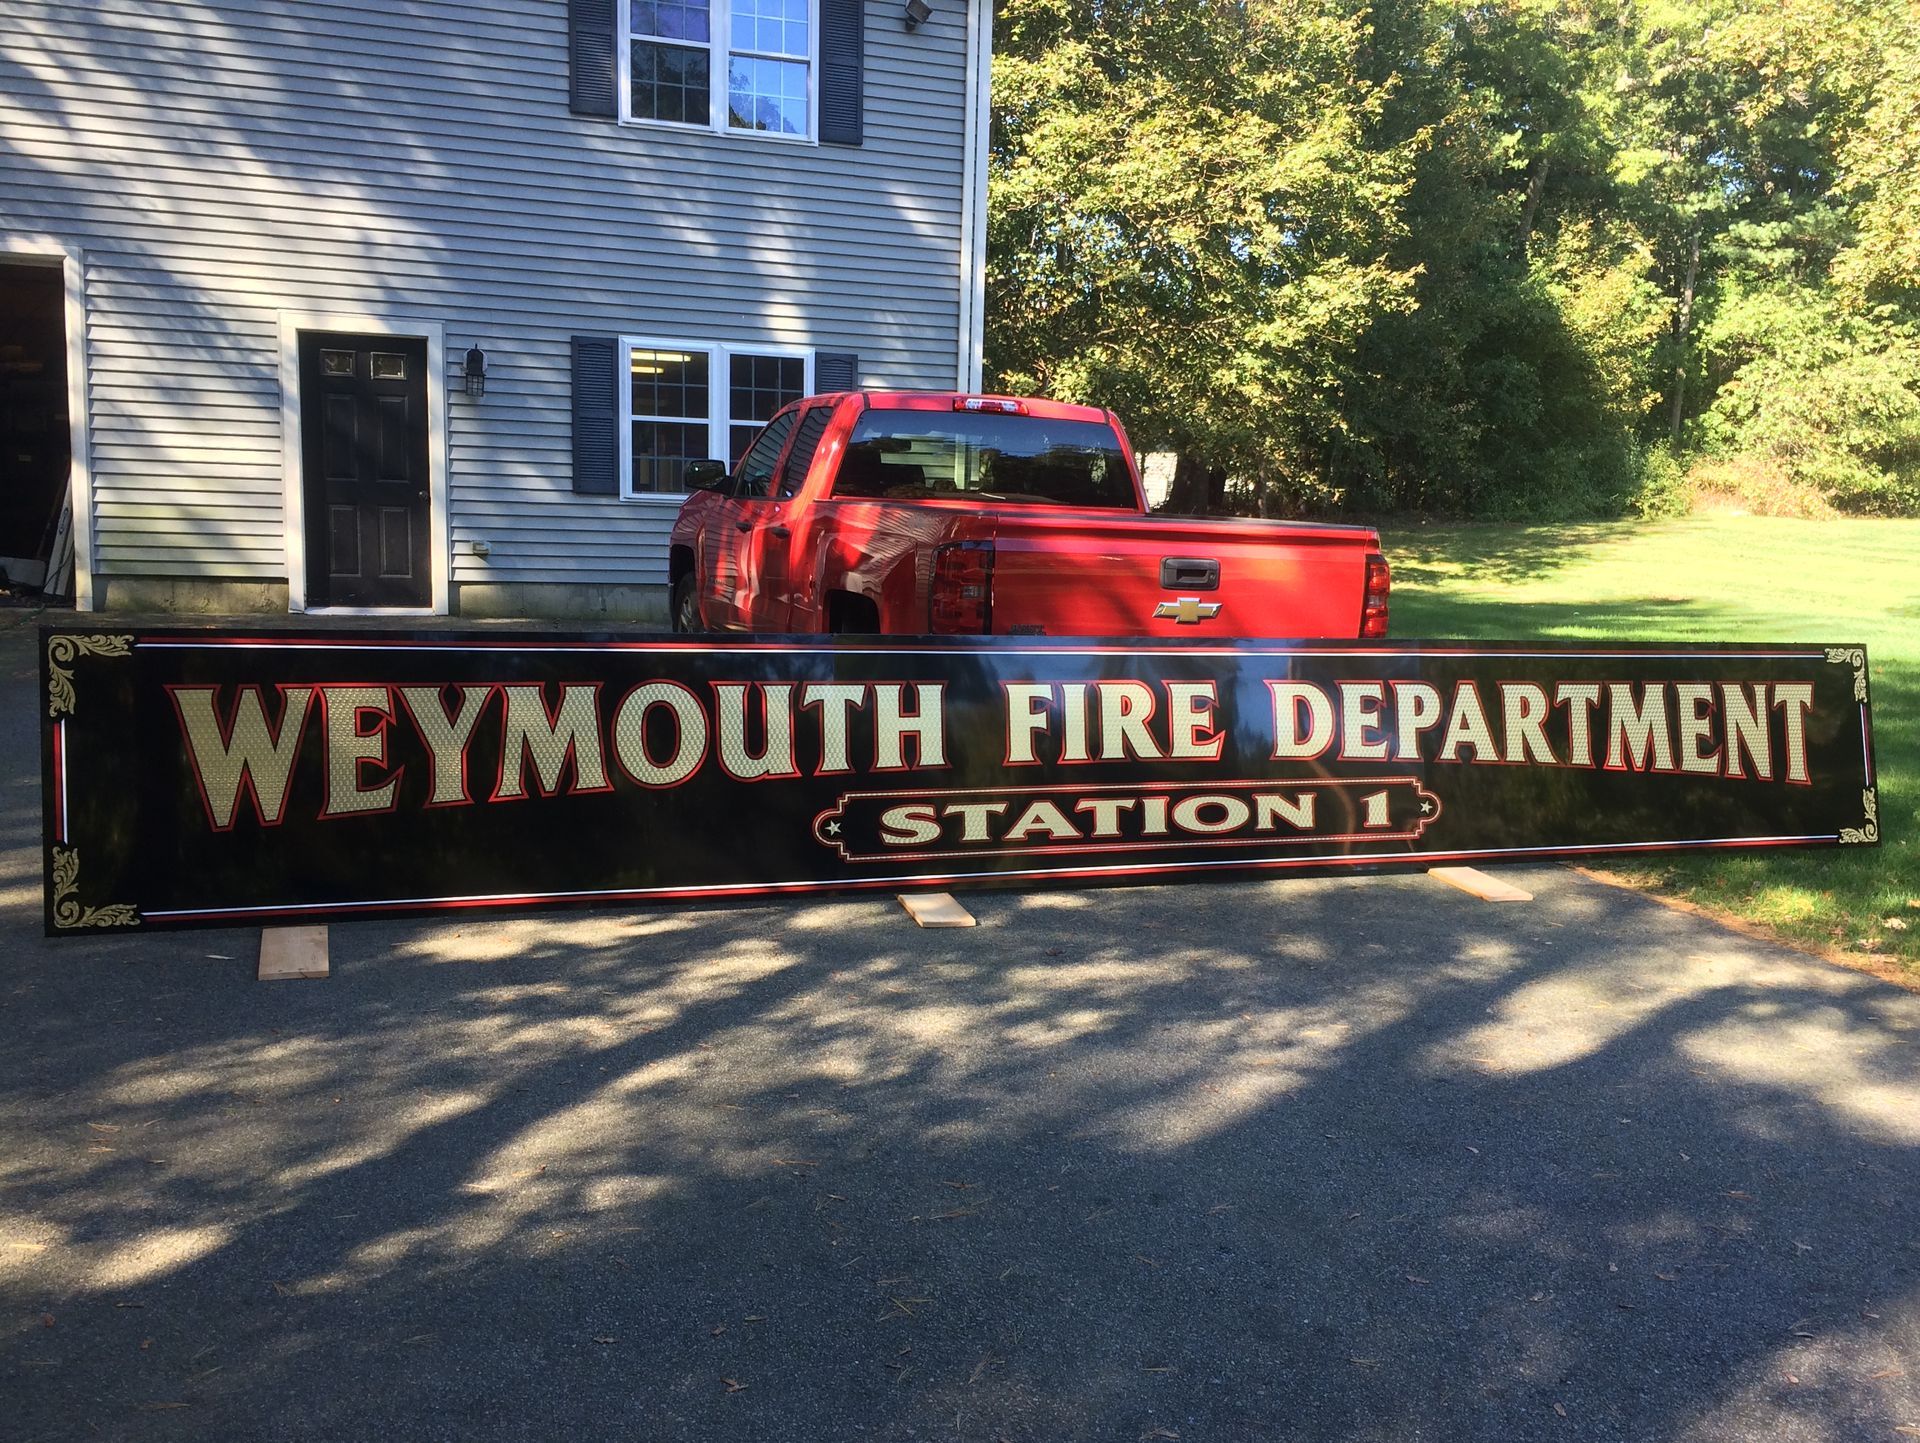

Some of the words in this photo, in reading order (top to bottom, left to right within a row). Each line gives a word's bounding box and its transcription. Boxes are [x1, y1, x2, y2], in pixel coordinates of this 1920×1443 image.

[163, 679, 949, 832] WEYMOUTH
[1001, 679, 1226, 768] FIRE
[1263, 679, 1815, 786] DEPARTMENT
[878, 792, 1317, 846] STATION
[1359, 789, 1392, 828] 1
